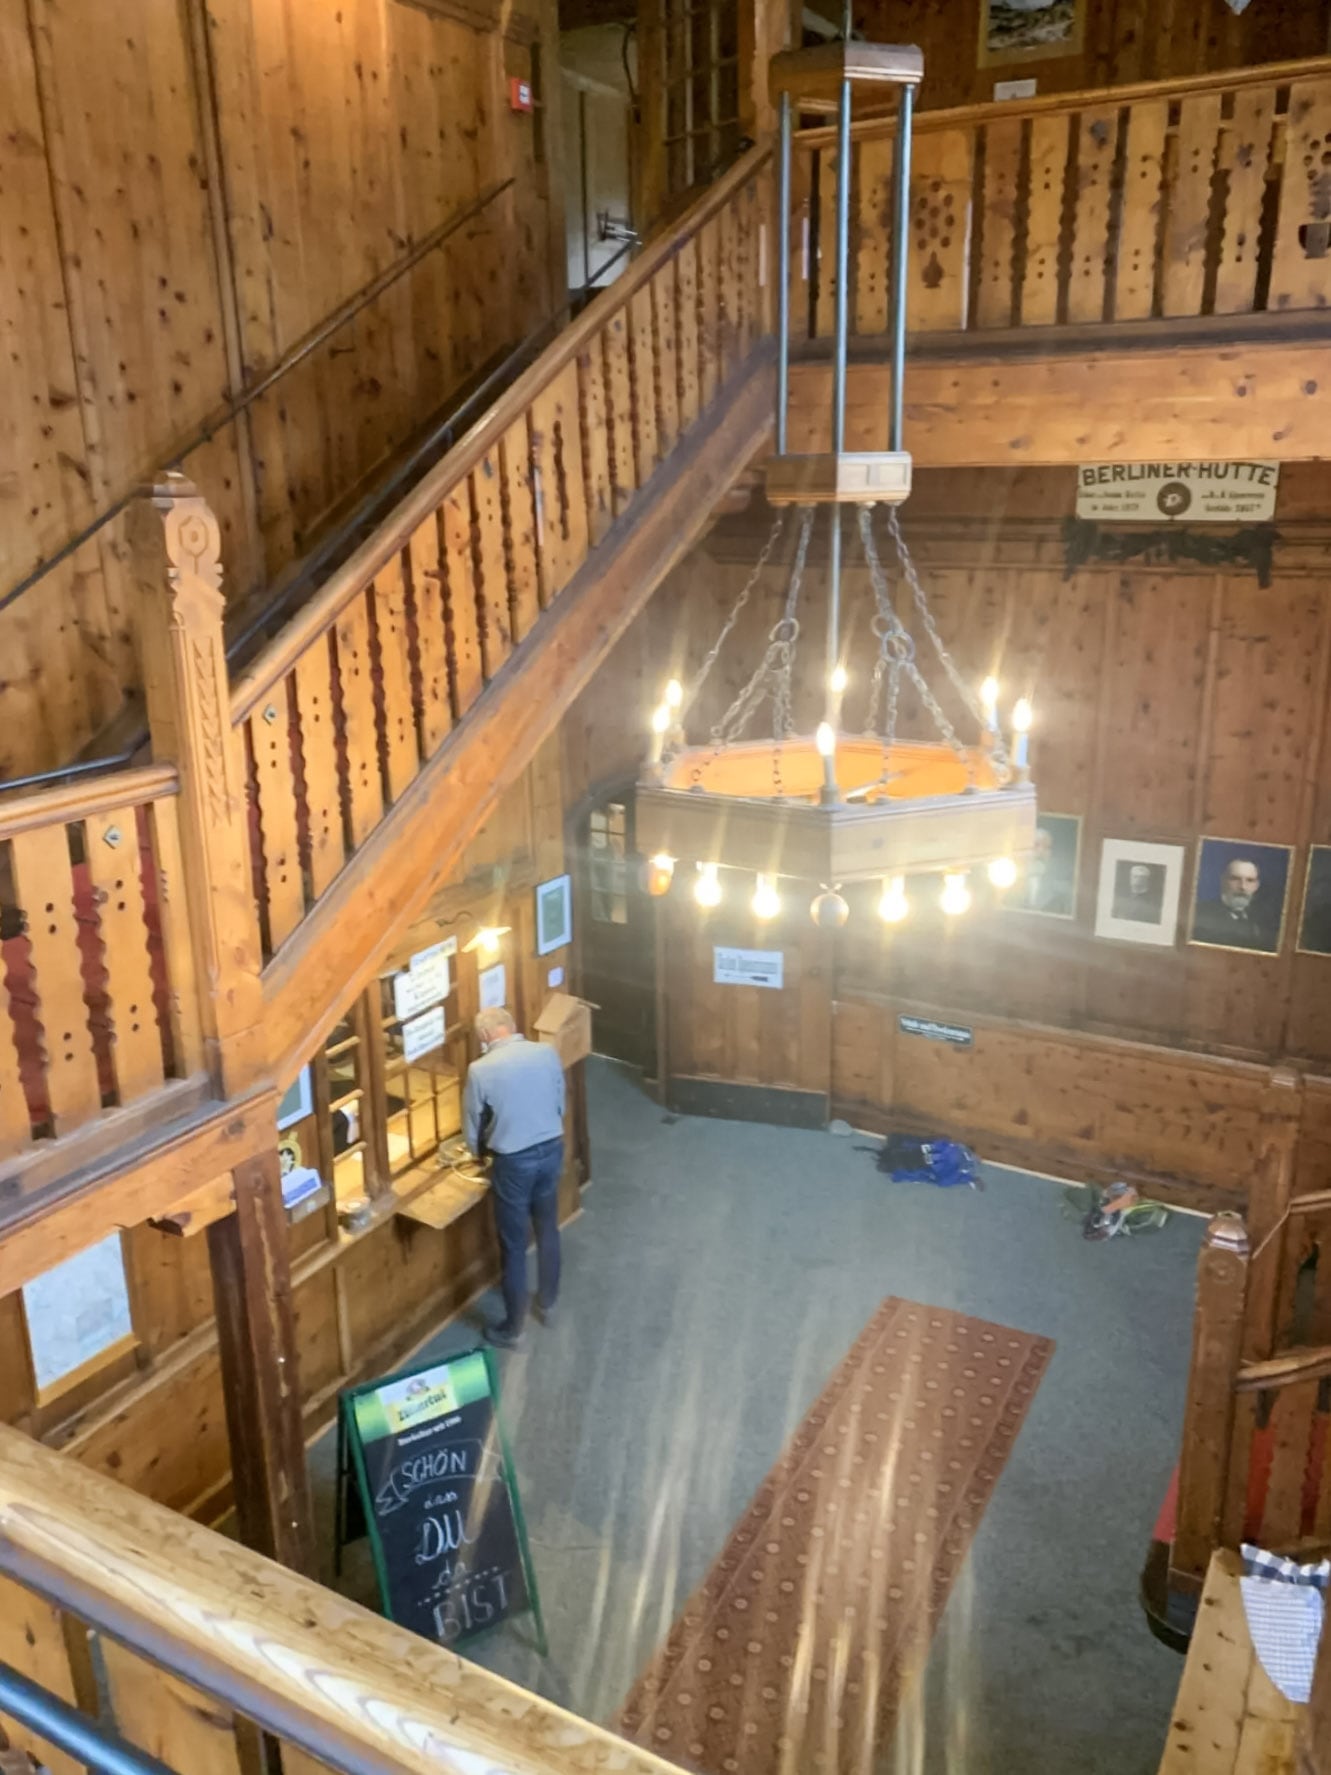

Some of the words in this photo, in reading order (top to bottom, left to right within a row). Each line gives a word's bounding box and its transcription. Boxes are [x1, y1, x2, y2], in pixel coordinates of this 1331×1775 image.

[401, 1449, 467, 1484] SCHÖN
[415, 1510, 478, 1565] DU
[432, 1569, 512, 1640] BIST
